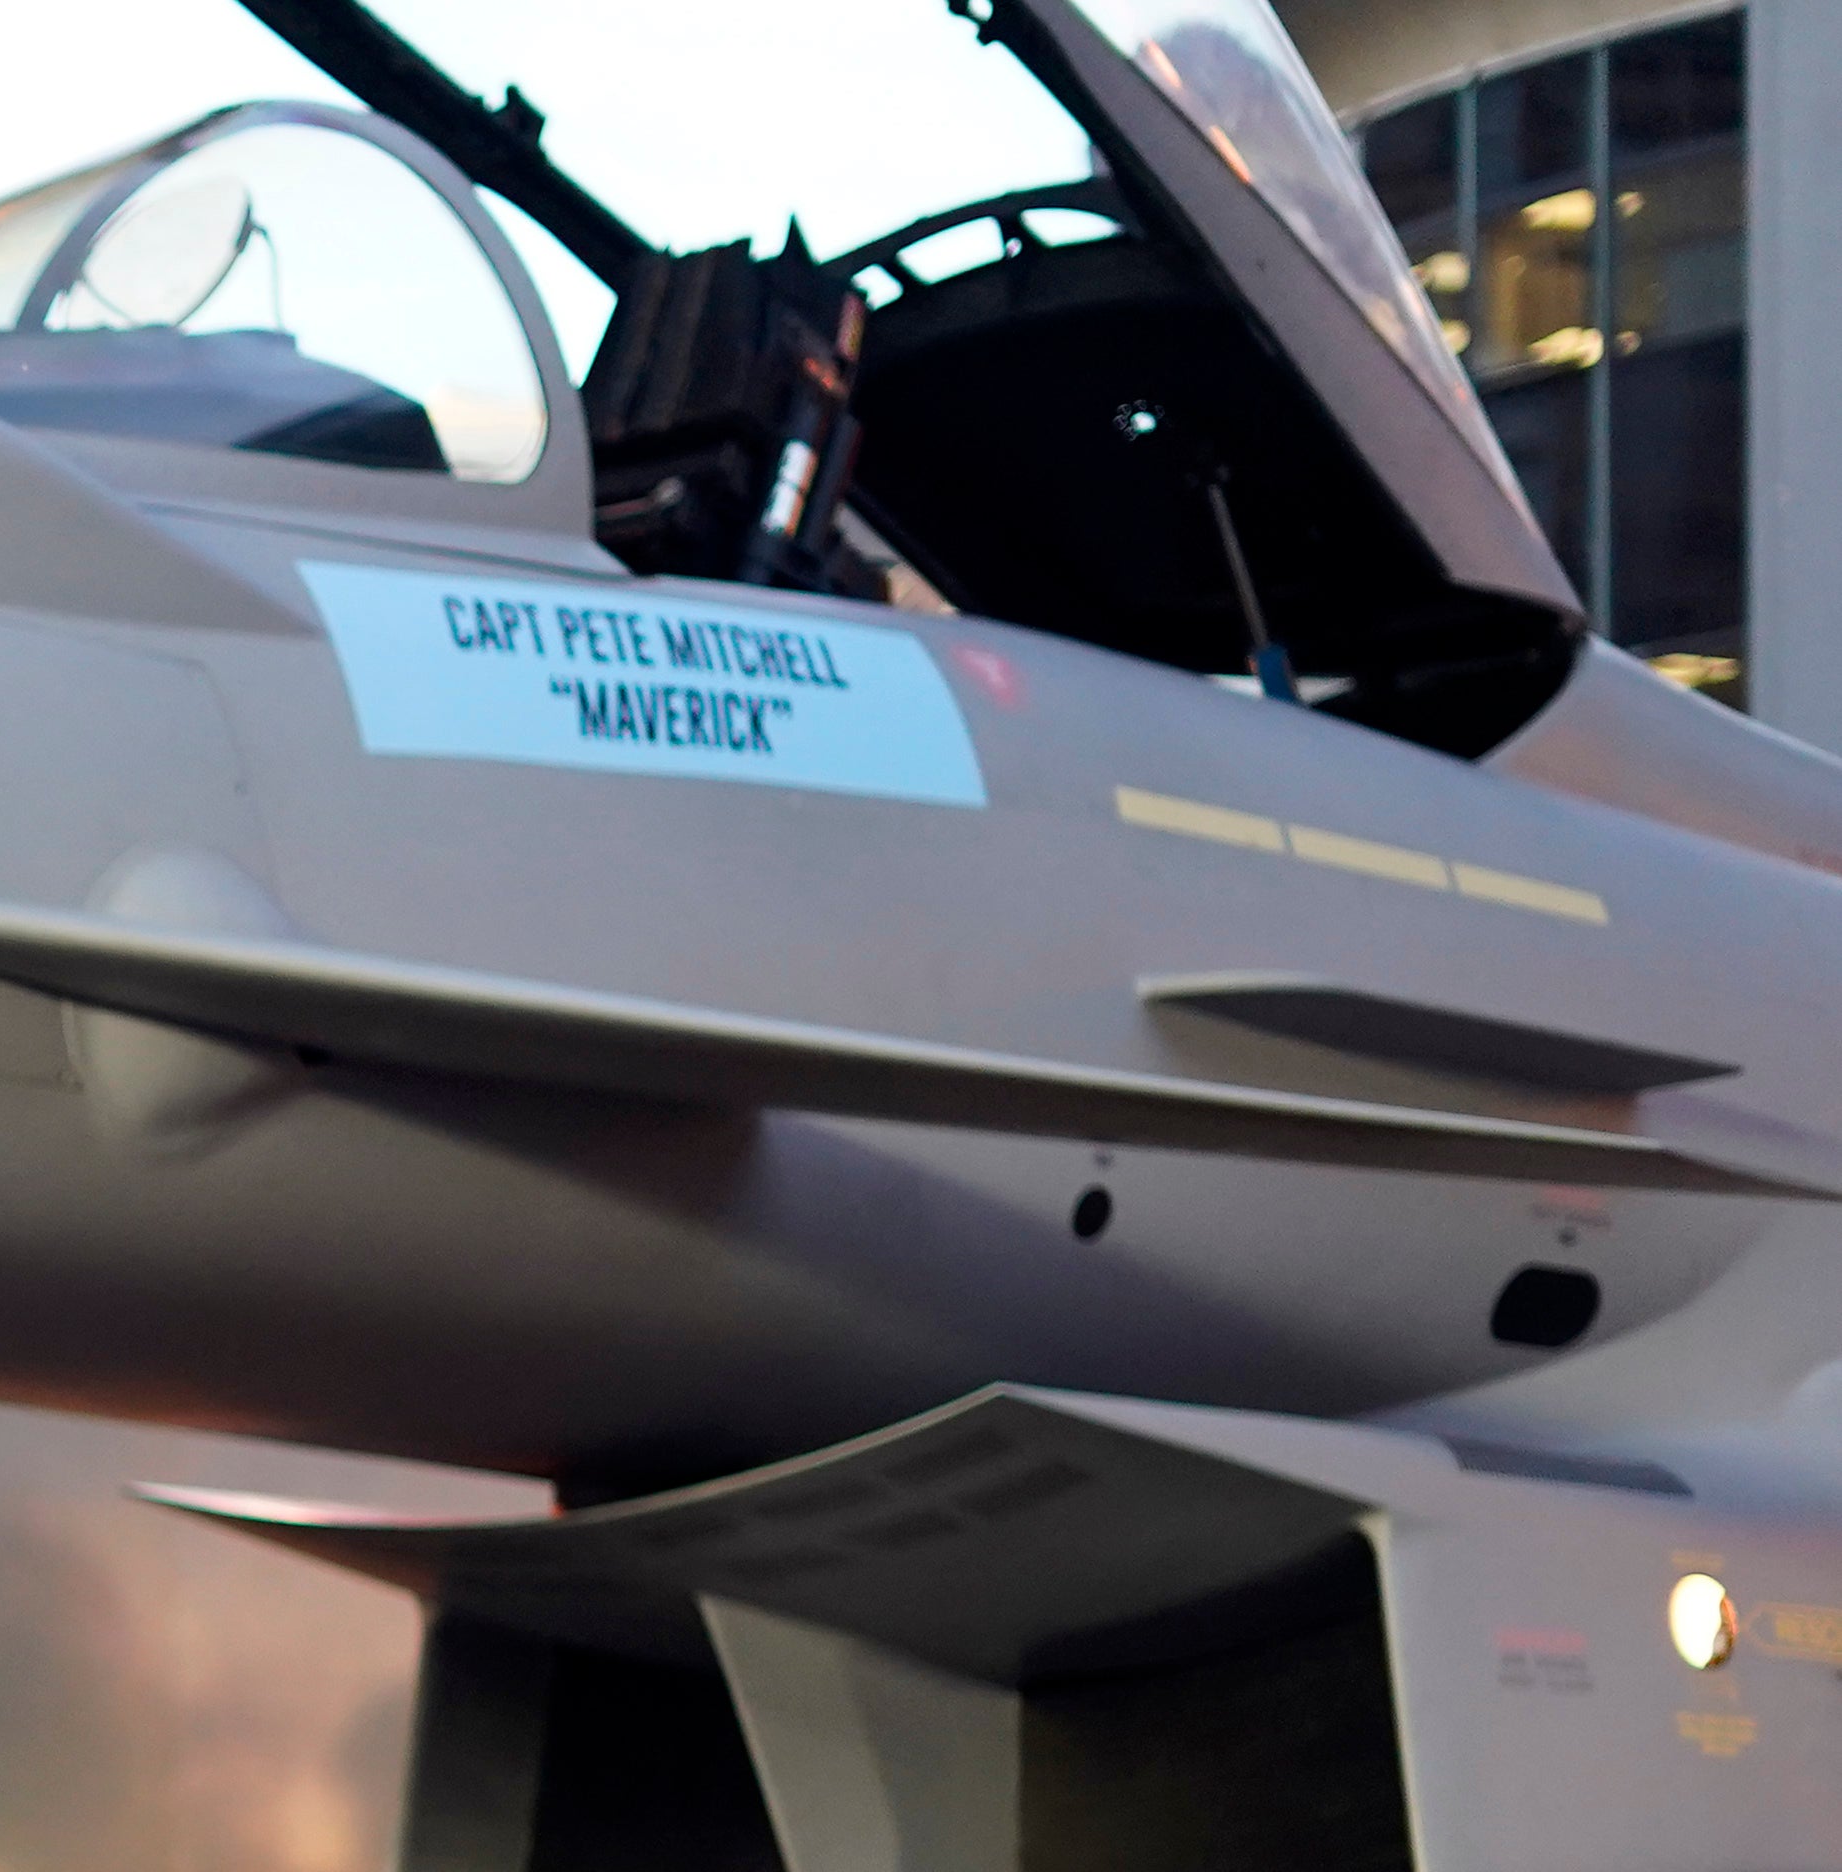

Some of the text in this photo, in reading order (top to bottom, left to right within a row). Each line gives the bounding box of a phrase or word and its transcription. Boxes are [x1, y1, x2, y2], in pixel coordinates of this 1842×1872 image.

[443, 596, 850, 690] CAPT PETE MITCHELL
